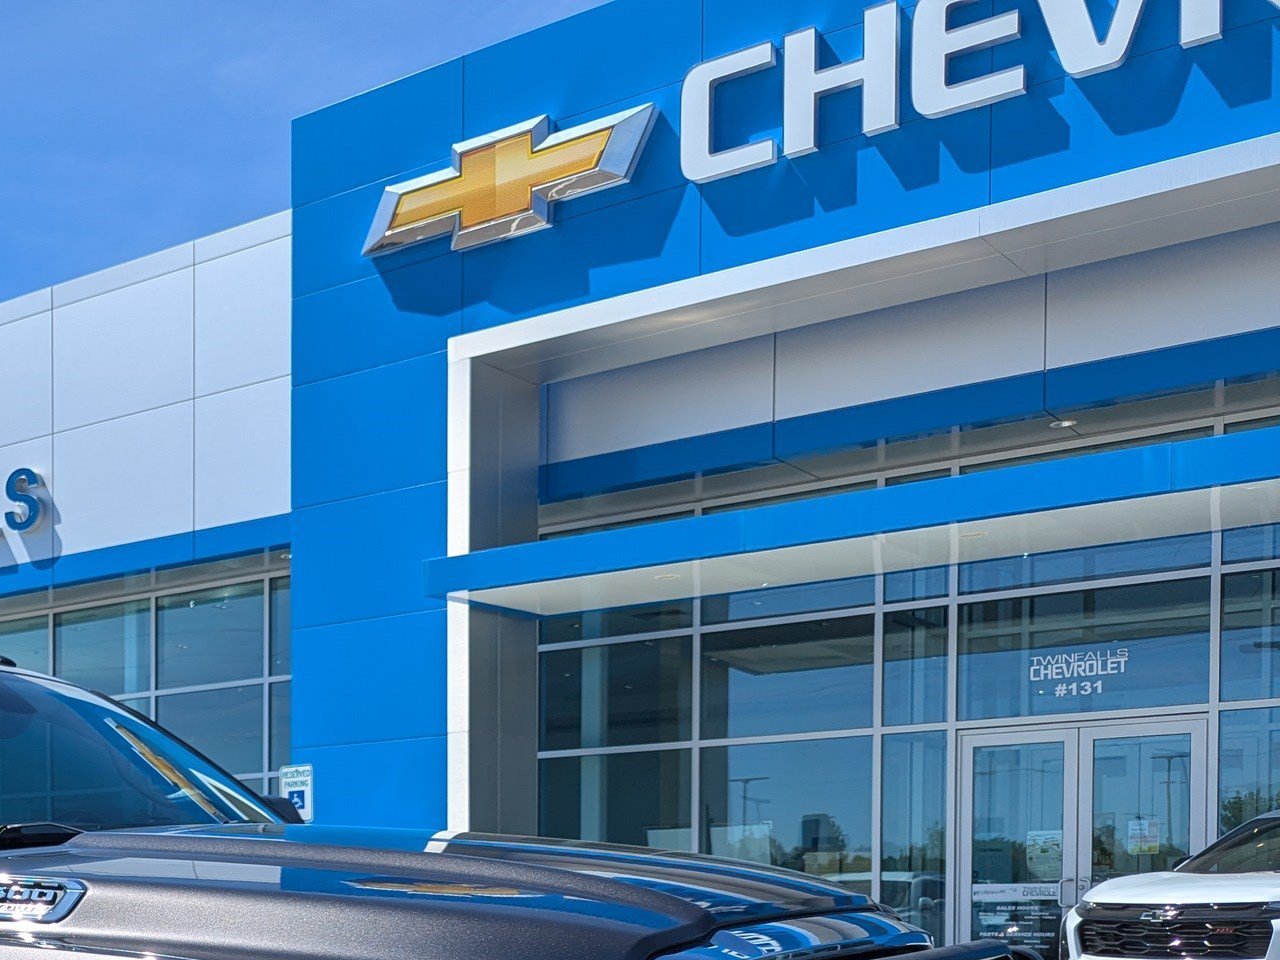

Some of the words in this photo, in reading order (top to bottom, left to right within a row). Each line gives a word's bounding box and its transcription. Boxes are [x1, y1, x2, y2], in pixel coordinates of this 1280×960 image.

[1030, 658, 1128, 681] CHEVROLET
[1055, 680, 1103, 697] #131
[282, 769, 310, 779] RESERVED
[283, 780, 309, 789] PARKING
